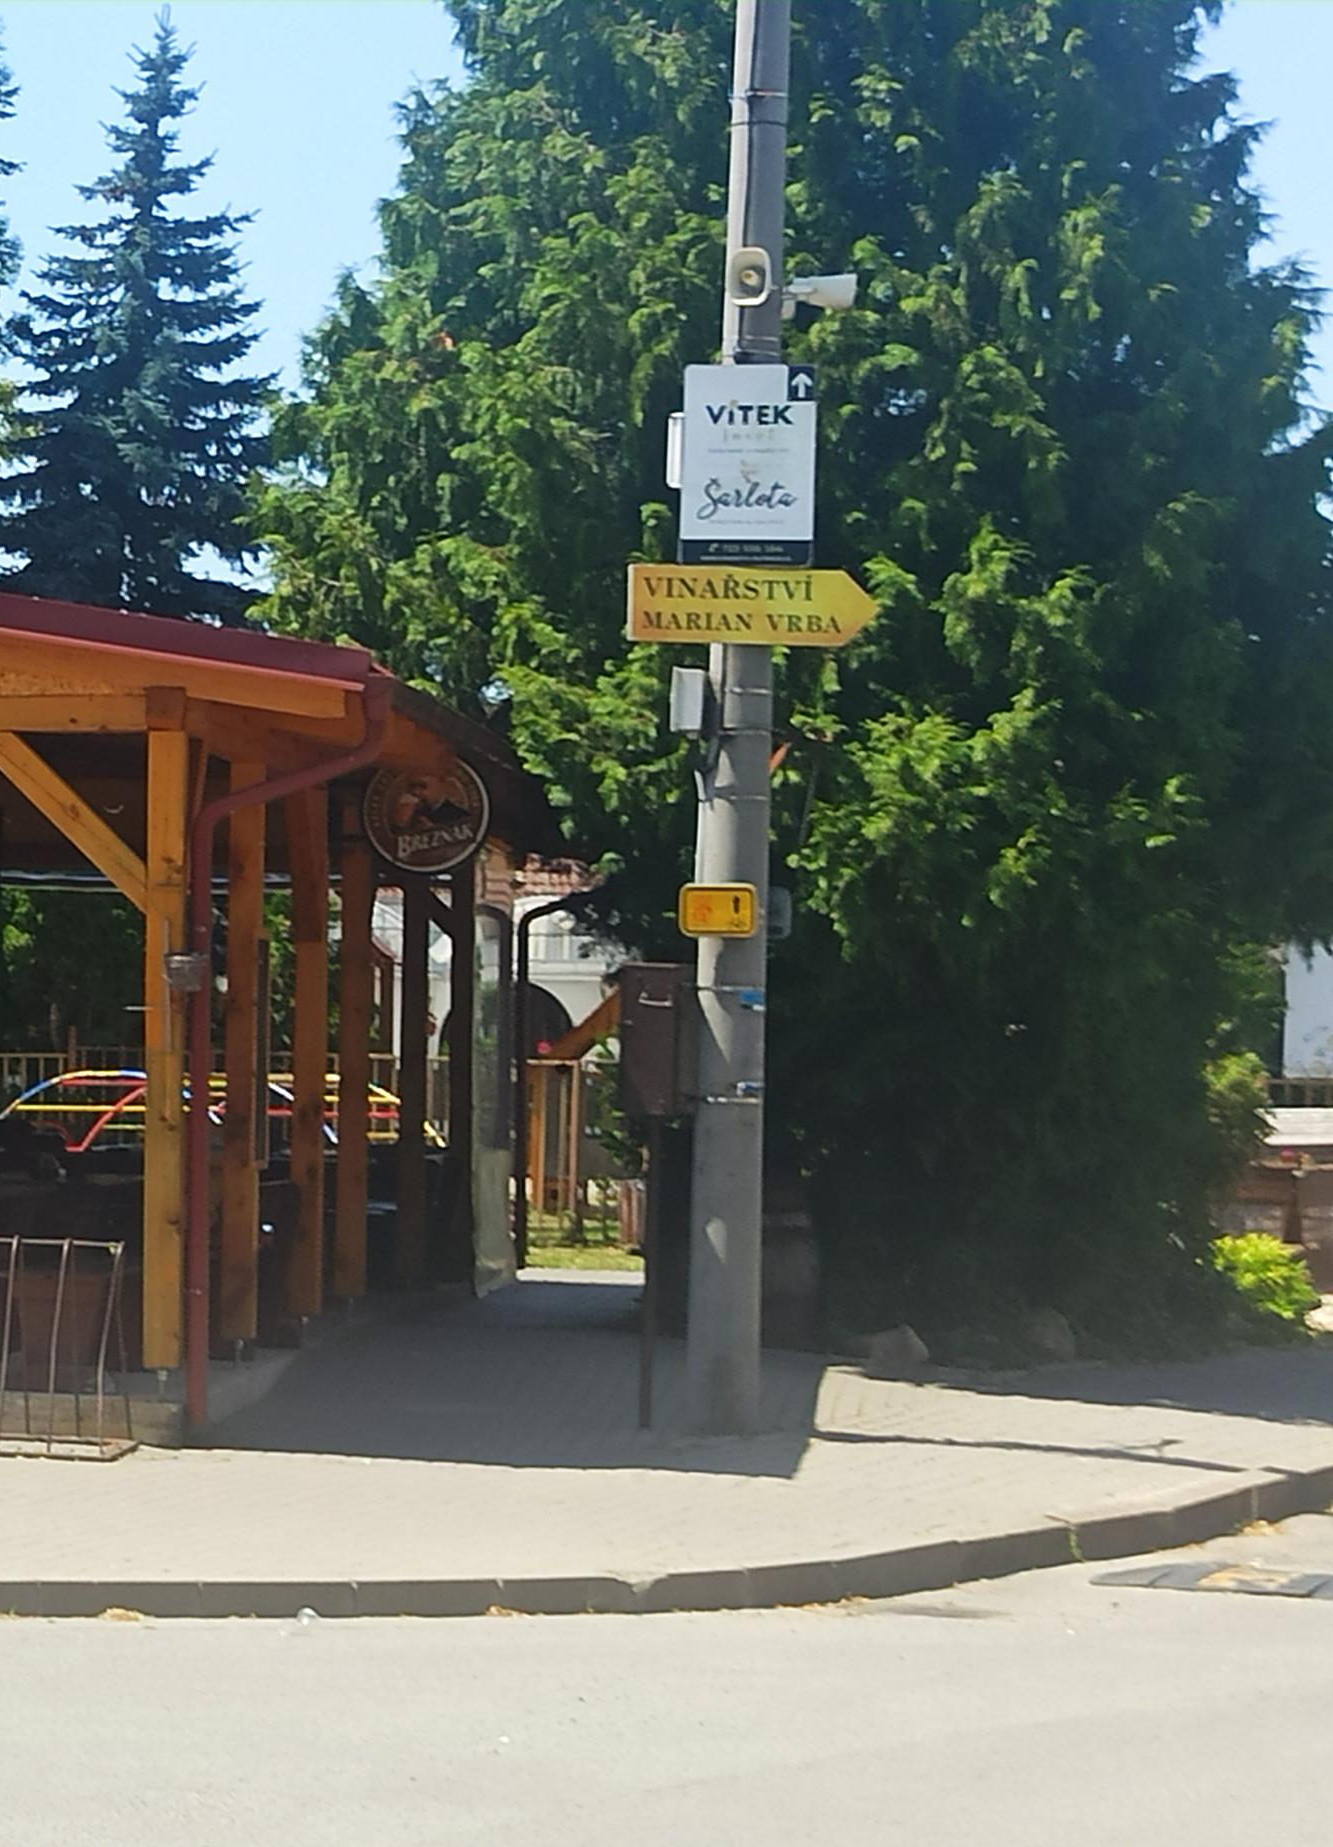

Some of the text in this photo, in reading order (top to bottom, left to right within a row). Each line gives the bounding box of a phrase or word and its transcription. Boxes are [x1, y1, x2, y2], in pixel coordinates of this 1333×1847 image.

[643, 574, 813, 601] VINAŘSTVÍ
[642, 611, 841, 634] MARIAN VRBA
